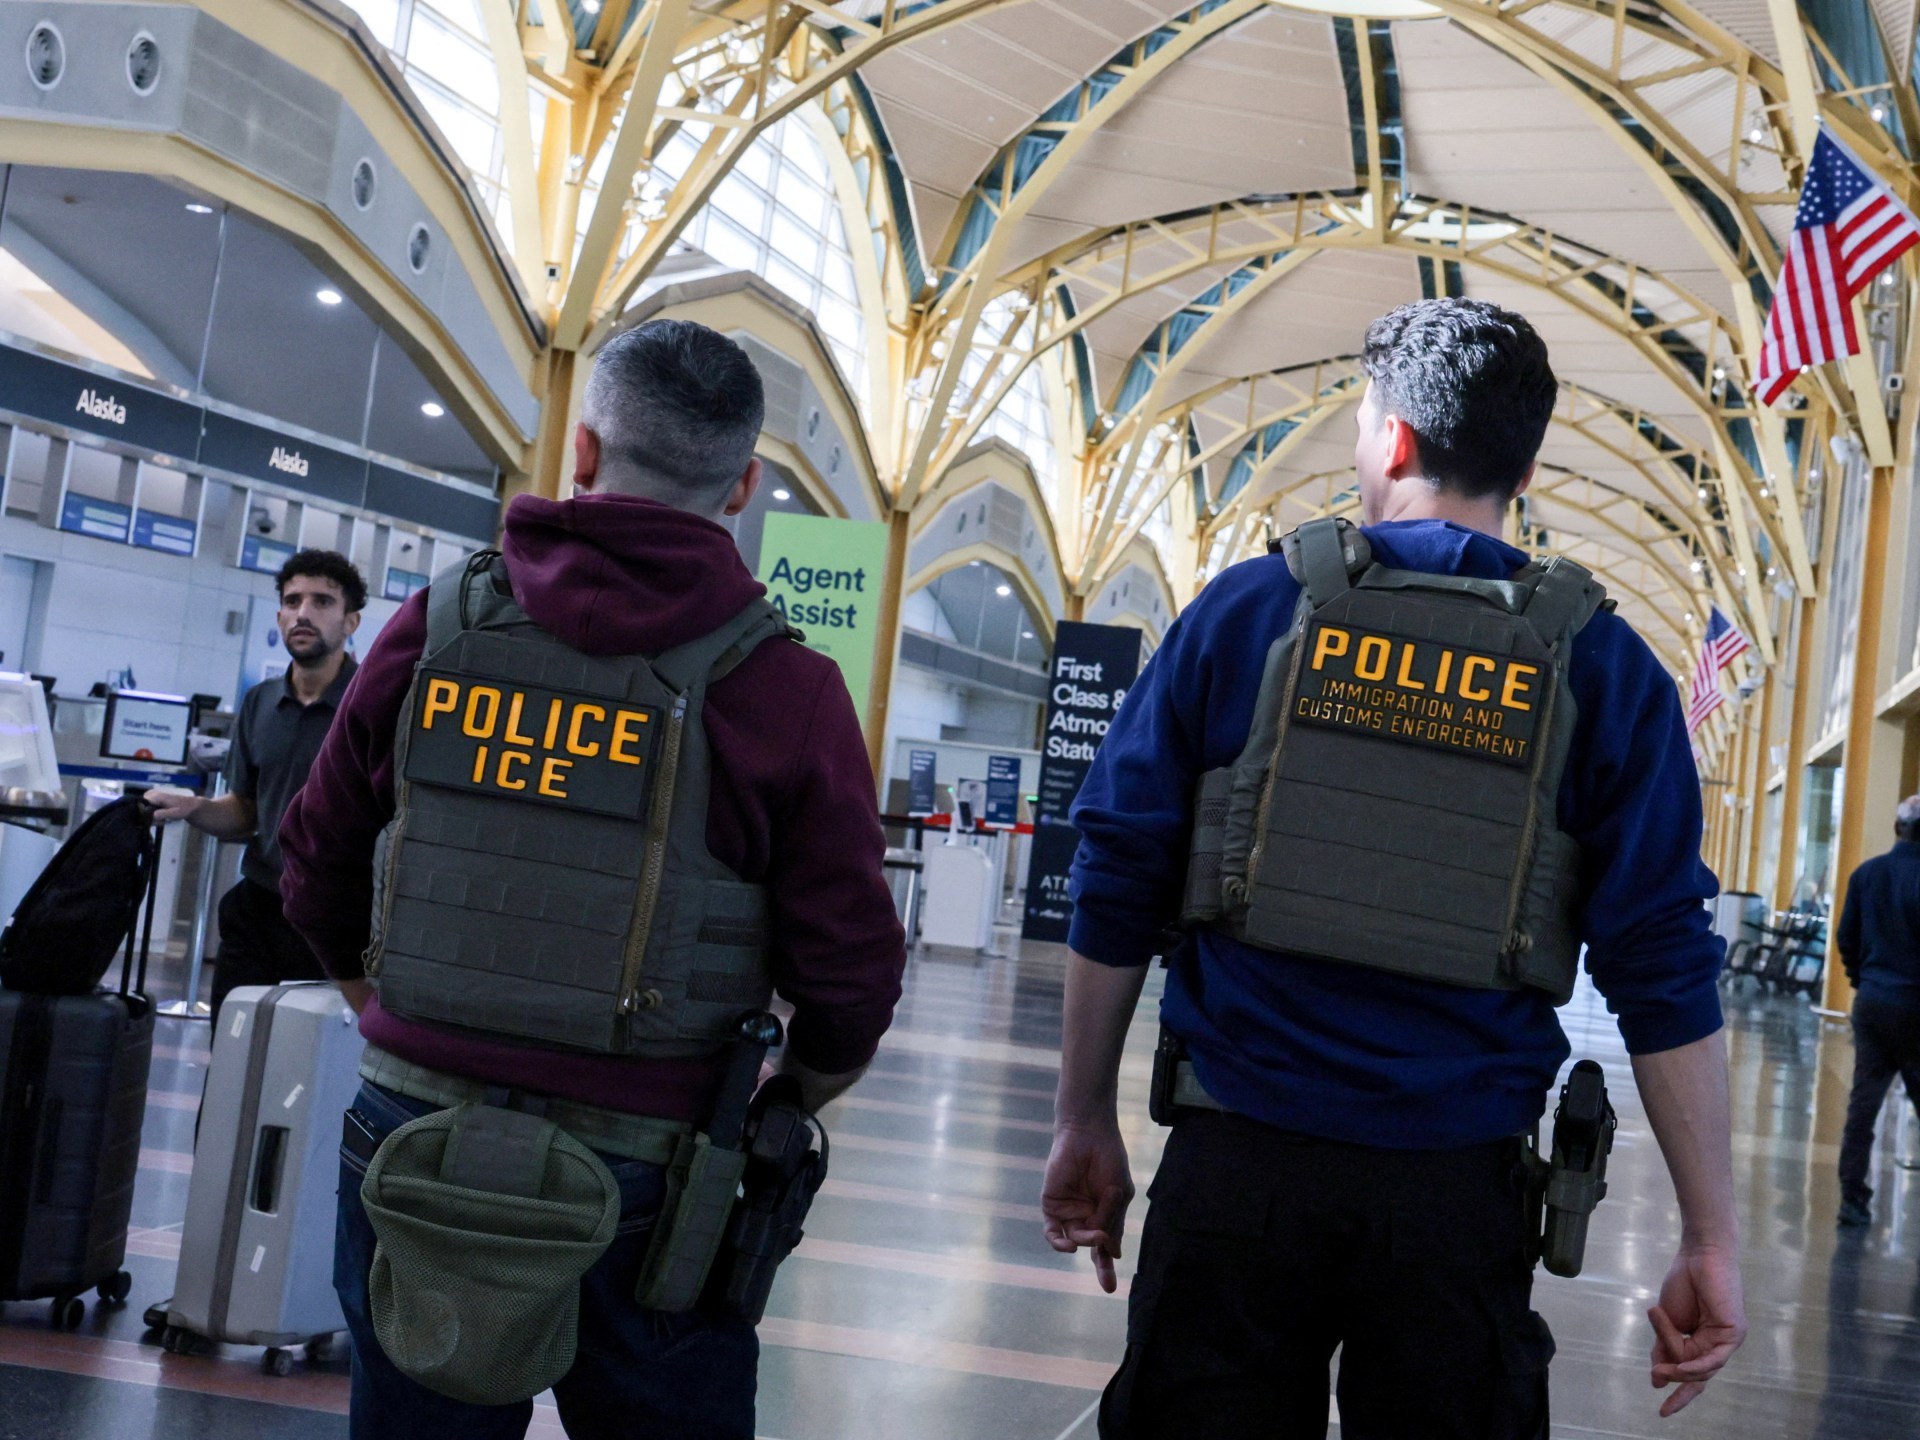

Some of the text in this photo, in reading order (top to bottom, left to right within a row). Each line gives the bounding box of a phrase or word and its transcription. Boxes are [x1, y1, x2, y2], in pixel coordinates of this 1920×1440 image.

[76, 389, 127, 425] Alaska
[269, 447, 309, 477] Alaska
[769, 557, 866, 594] Agent
[772, 593, 857, 629] Assist
[1056, 656, 1103, 682] First
[1311, 626, 1538, 711] POLICE
[1053, 683, 1109, 709] Class
[1321, 679, 1504, 731] IMMIGRATION AND
[422, 677, 649, 765] POLICE
[1049, 709, 1110, 736] Atmo
[1297, 697, 1526, 757] CUSTOMS ENFORCEMENT
[472, 746, 574, 798] ICE
